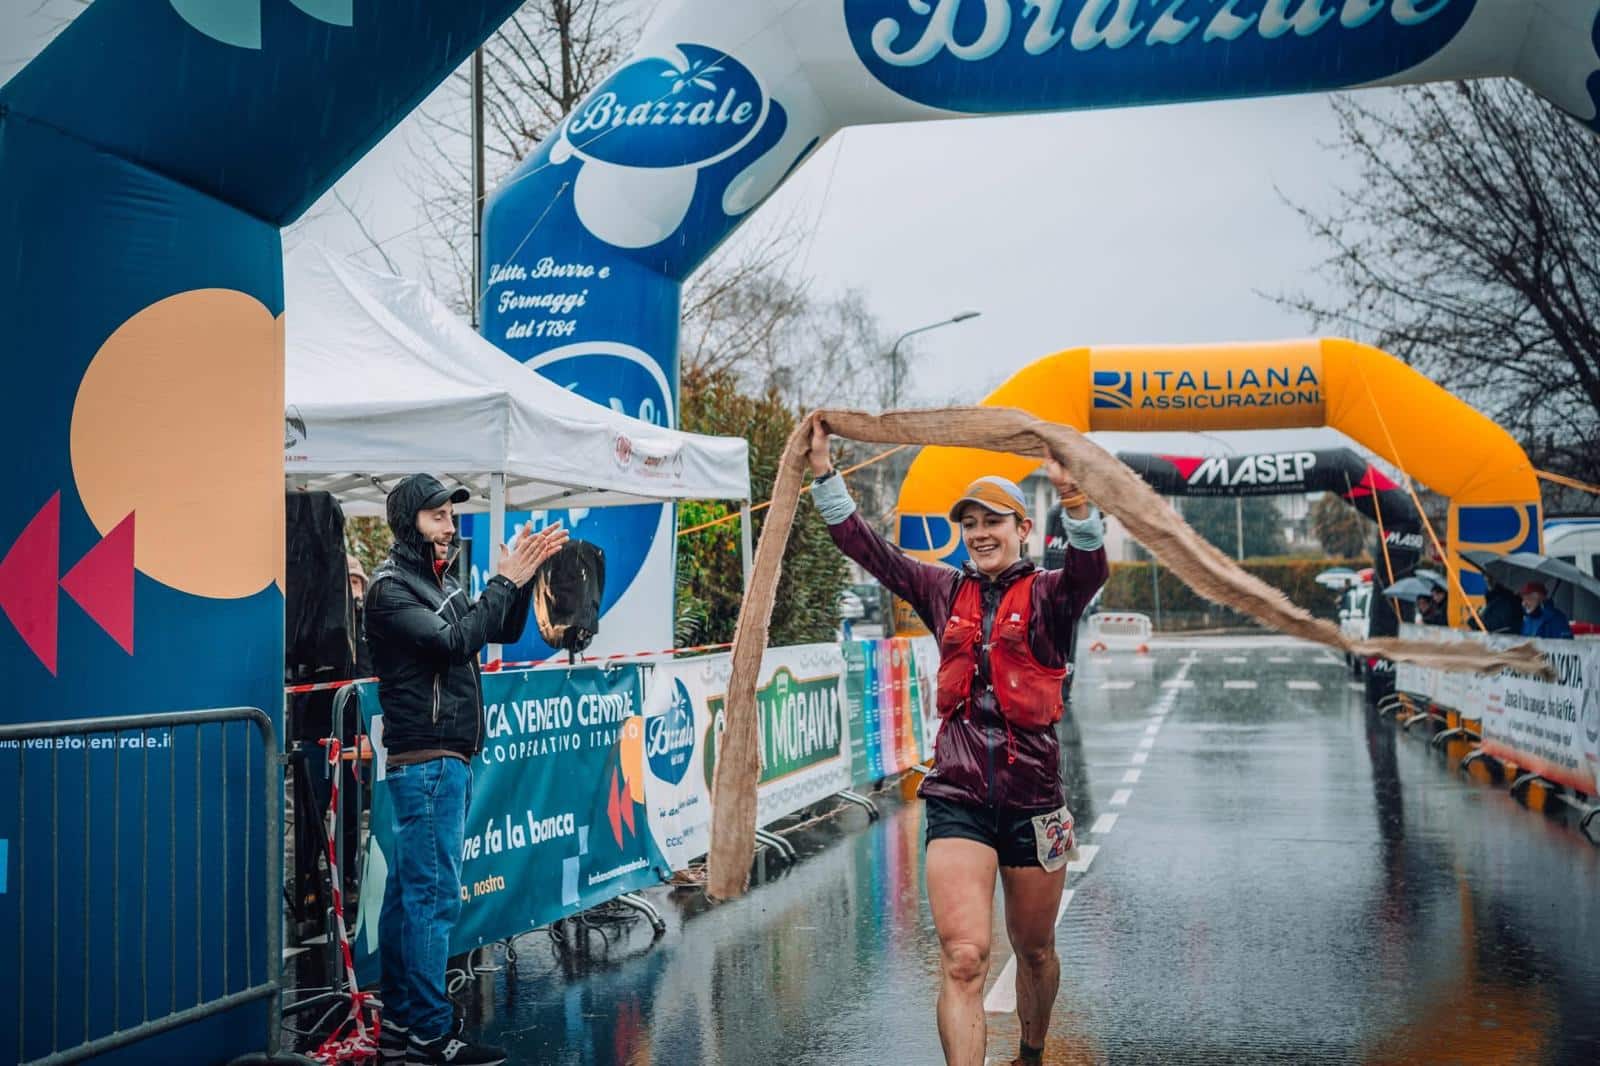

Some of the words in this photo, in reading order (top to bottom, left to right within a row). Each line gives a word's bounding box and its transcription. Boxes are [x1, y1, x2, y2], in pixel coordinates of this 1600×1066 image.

[871, 0, 1449, 67] Brazza
[570, 88, 754, 134] Brazzale
[531, 256, 595, 279] Burro
[598, 265, 610, 279] e
[497, 288, 589, 314] Formaggi
[505, 319, 535, 339] dal
[536, 319, 577, 337] 1784
[1142, 364, 1319, 391] ITALIANA
[1140, 390, 1321, 409] ASSICURAZIONI
[1187, 452, 1317, 486] MASEP
[484, 703, 512, 739] CA
[512, 695, 573, 734] VENETO
[771, 687, 840, 768] MORAVIA
[481, 733, 581, 765] COOPERATIVO
[485, 818, 503, 855] fa
[506, 814, 526, 850] la
[527, 809, 575, 845] banca
[474, 873, 506, 897] nostra
